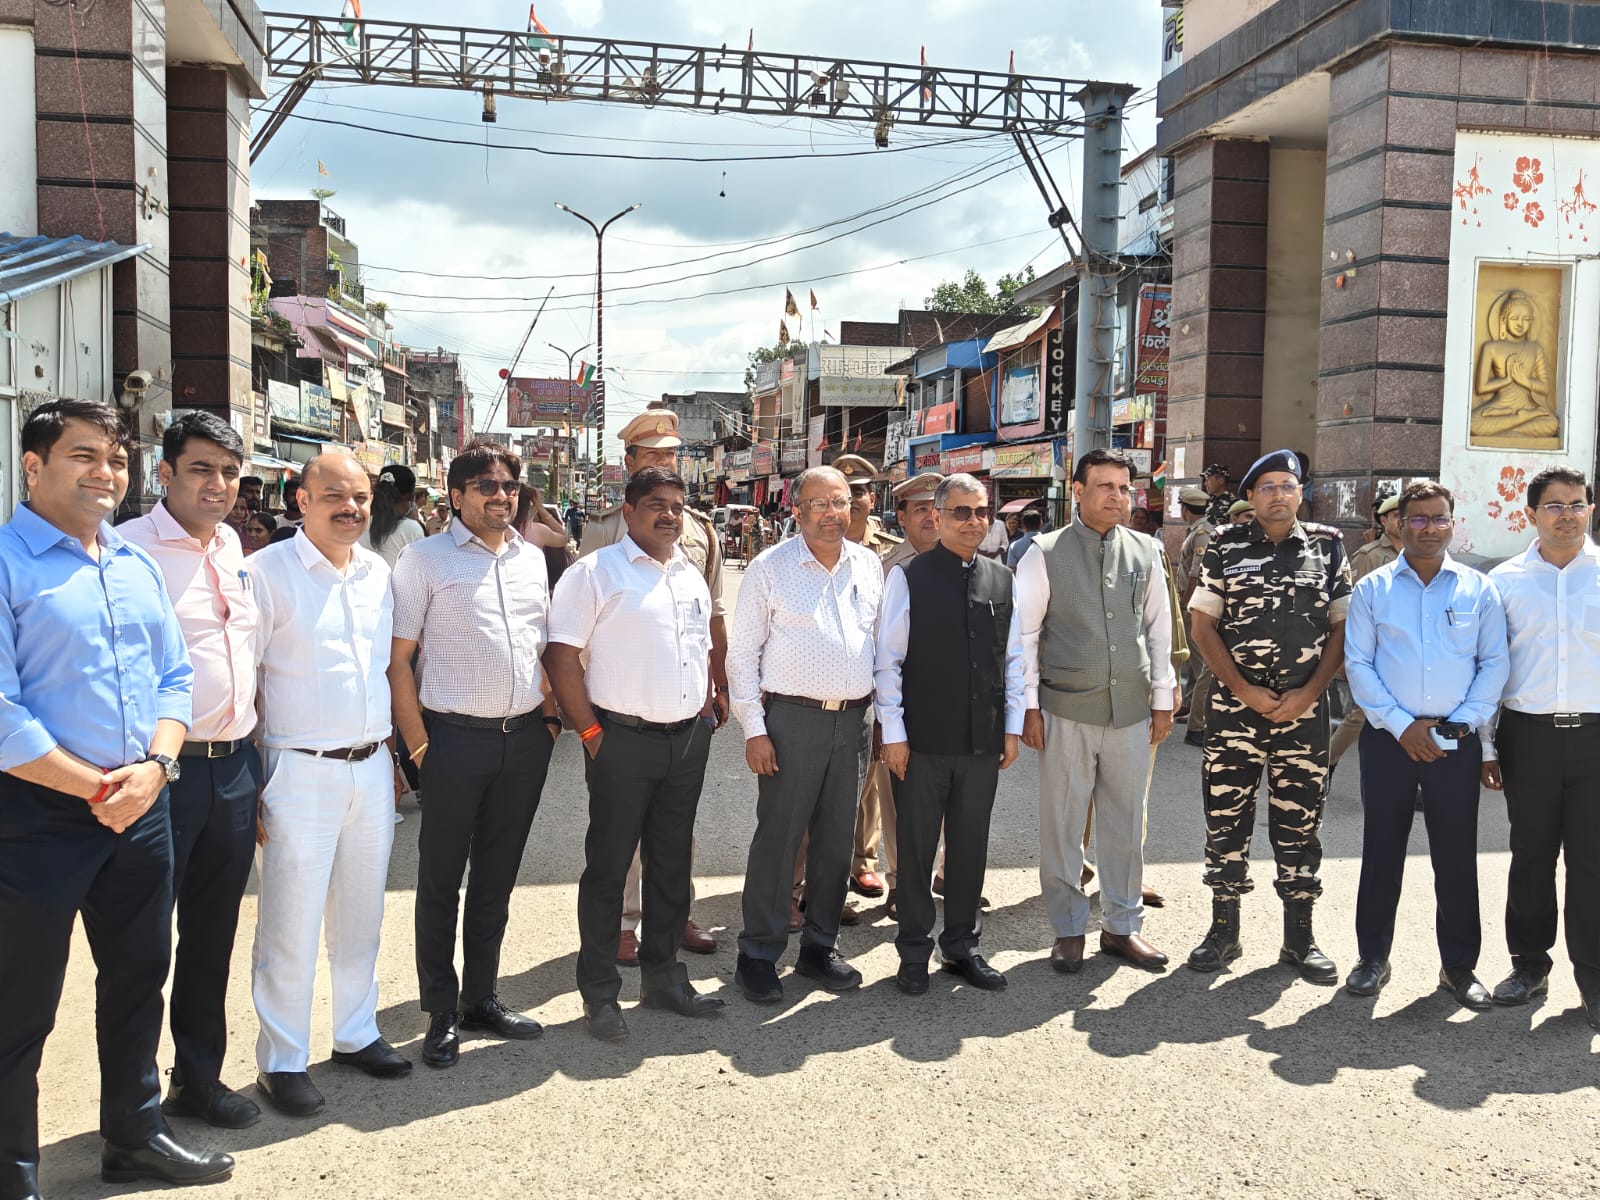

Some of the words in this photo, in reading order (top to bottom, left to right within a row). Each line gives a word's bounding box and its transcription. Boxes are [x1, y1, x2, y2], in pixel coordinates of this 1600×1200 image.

[1141, 331, 1171, 349] कले
[1051, 331, 1064, 430] JOCKEY
[1140, 375, 1168, 389] कपड़ा
